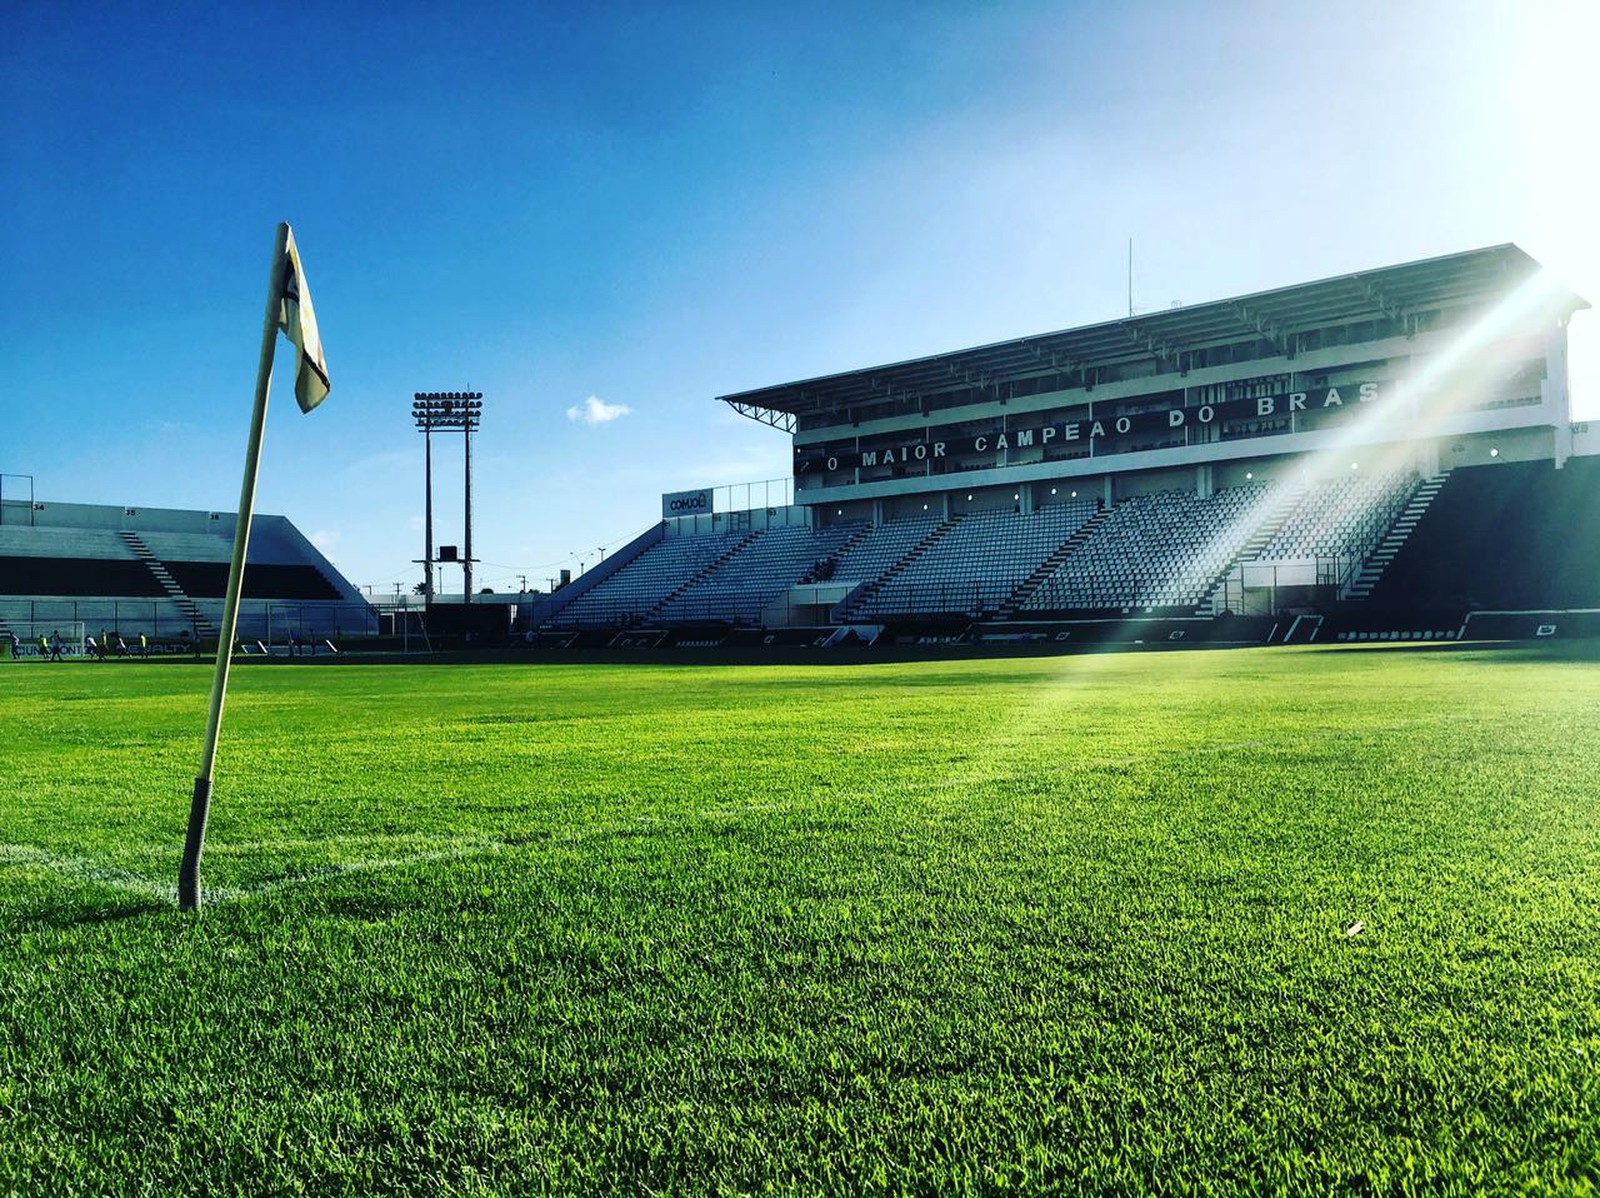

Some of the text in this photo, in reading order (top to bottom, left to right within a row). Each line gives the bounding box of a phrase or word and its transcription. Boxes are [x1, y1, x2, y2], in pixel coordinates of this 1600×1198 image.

[827, 380, 1402, 471] O MAIOR CAMPEAO DO BRAS
[116, 643, 192, 655] ENALTY
